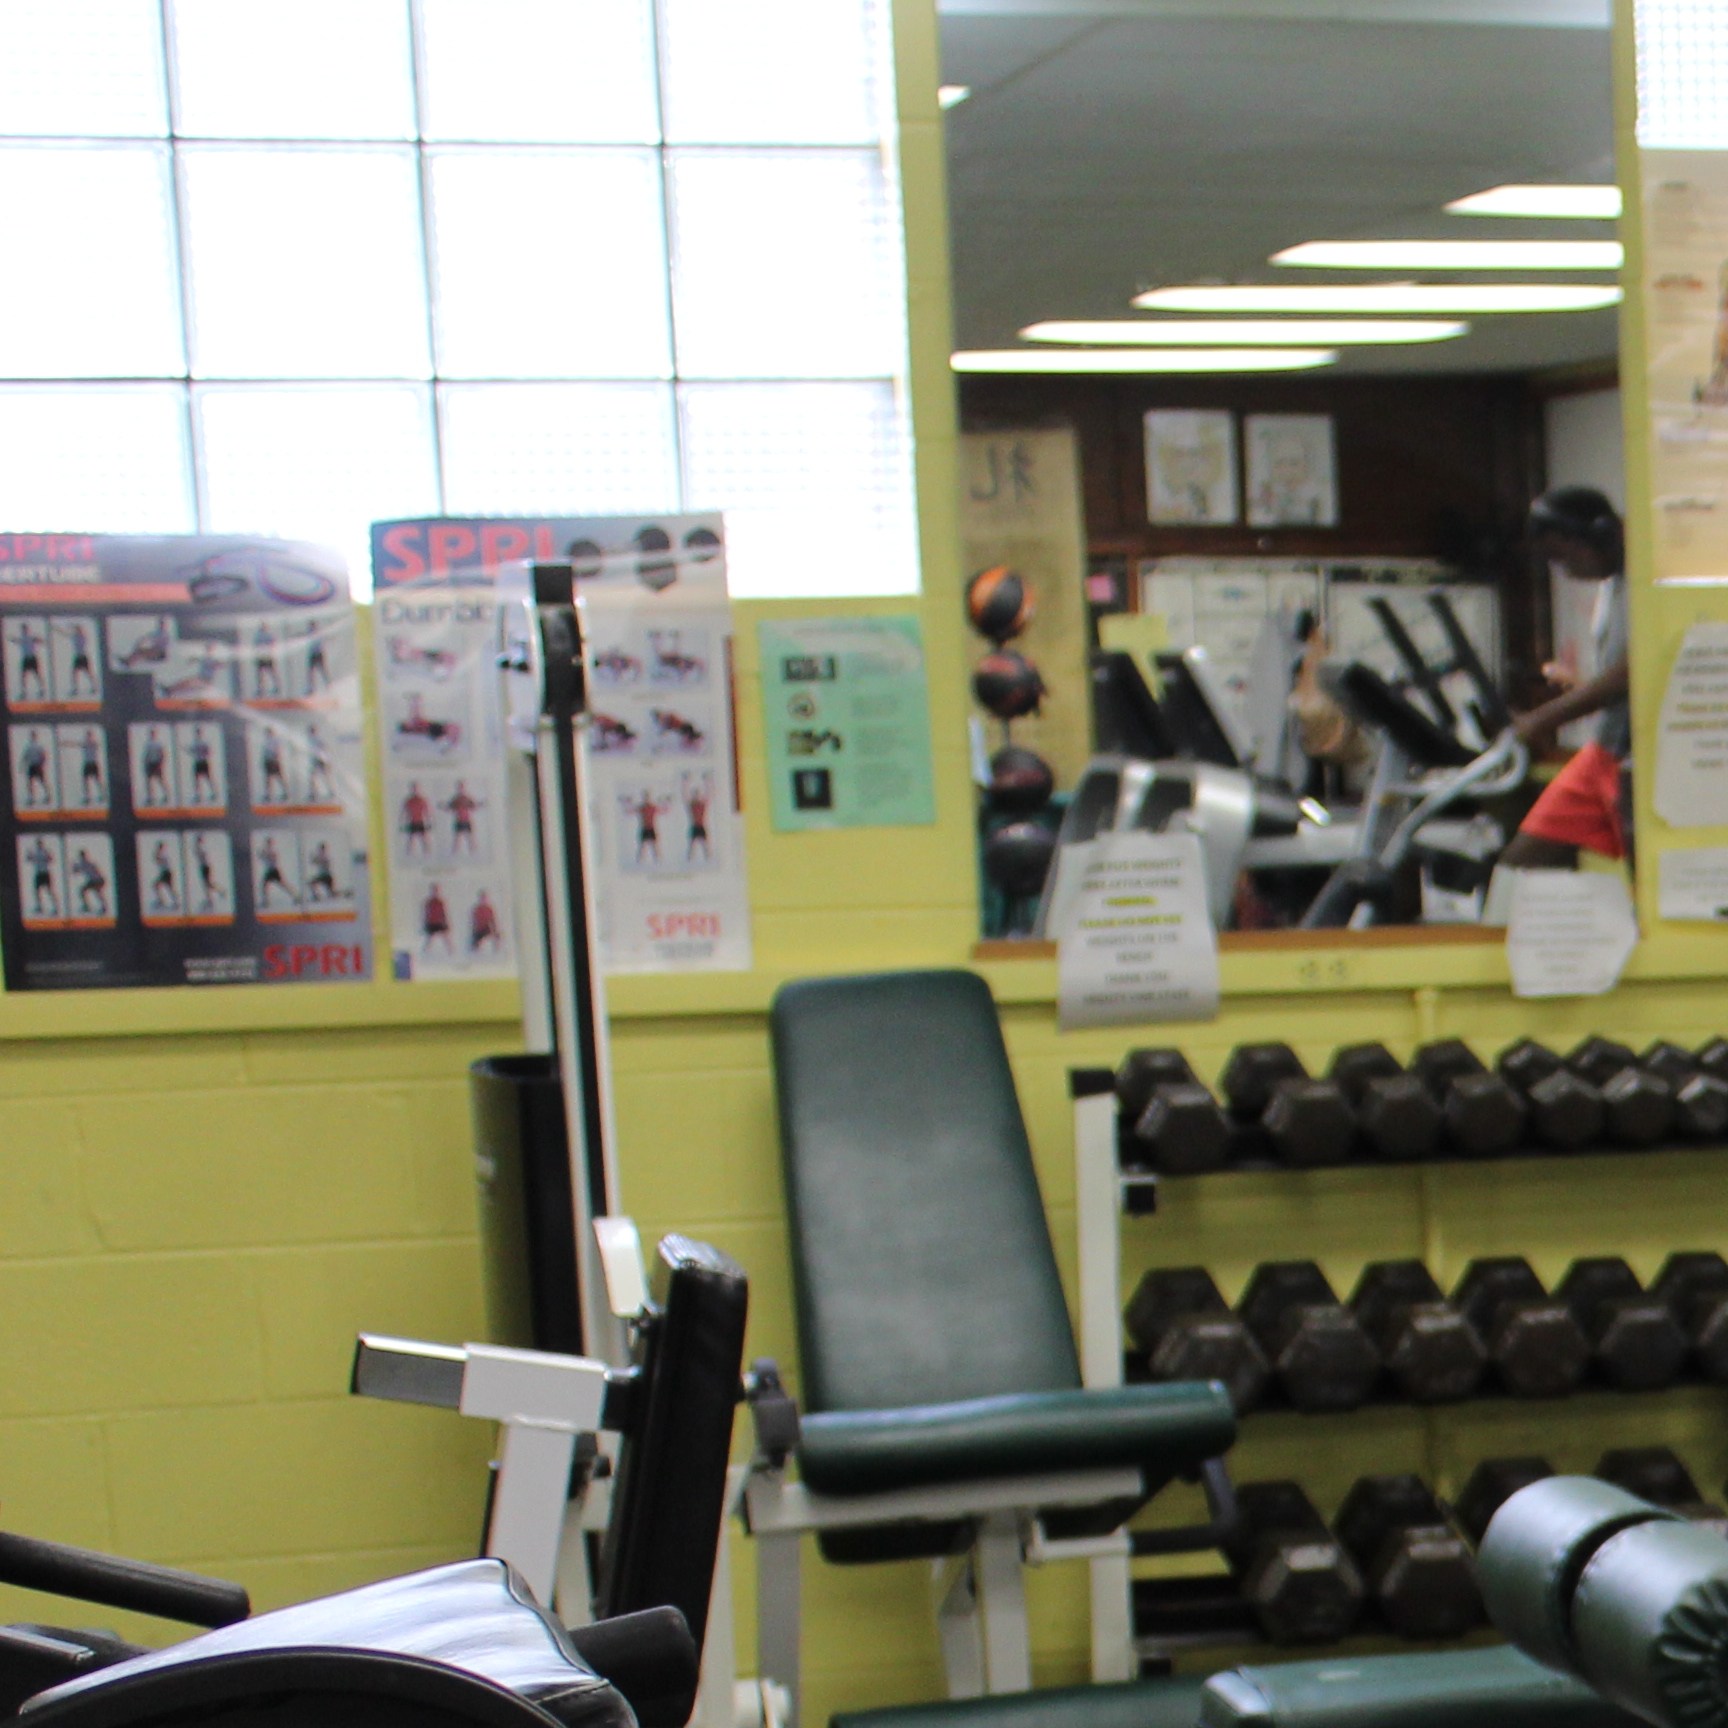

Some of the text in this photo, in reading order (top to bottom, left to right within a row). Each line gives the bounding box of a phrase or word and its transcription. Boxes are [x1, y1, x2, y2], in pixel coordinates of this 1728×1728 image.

[382, 524, 554, 582] SPRI
[646, 912, 720, 939] SPRI
[264, 944, 364, 978] SPRI
